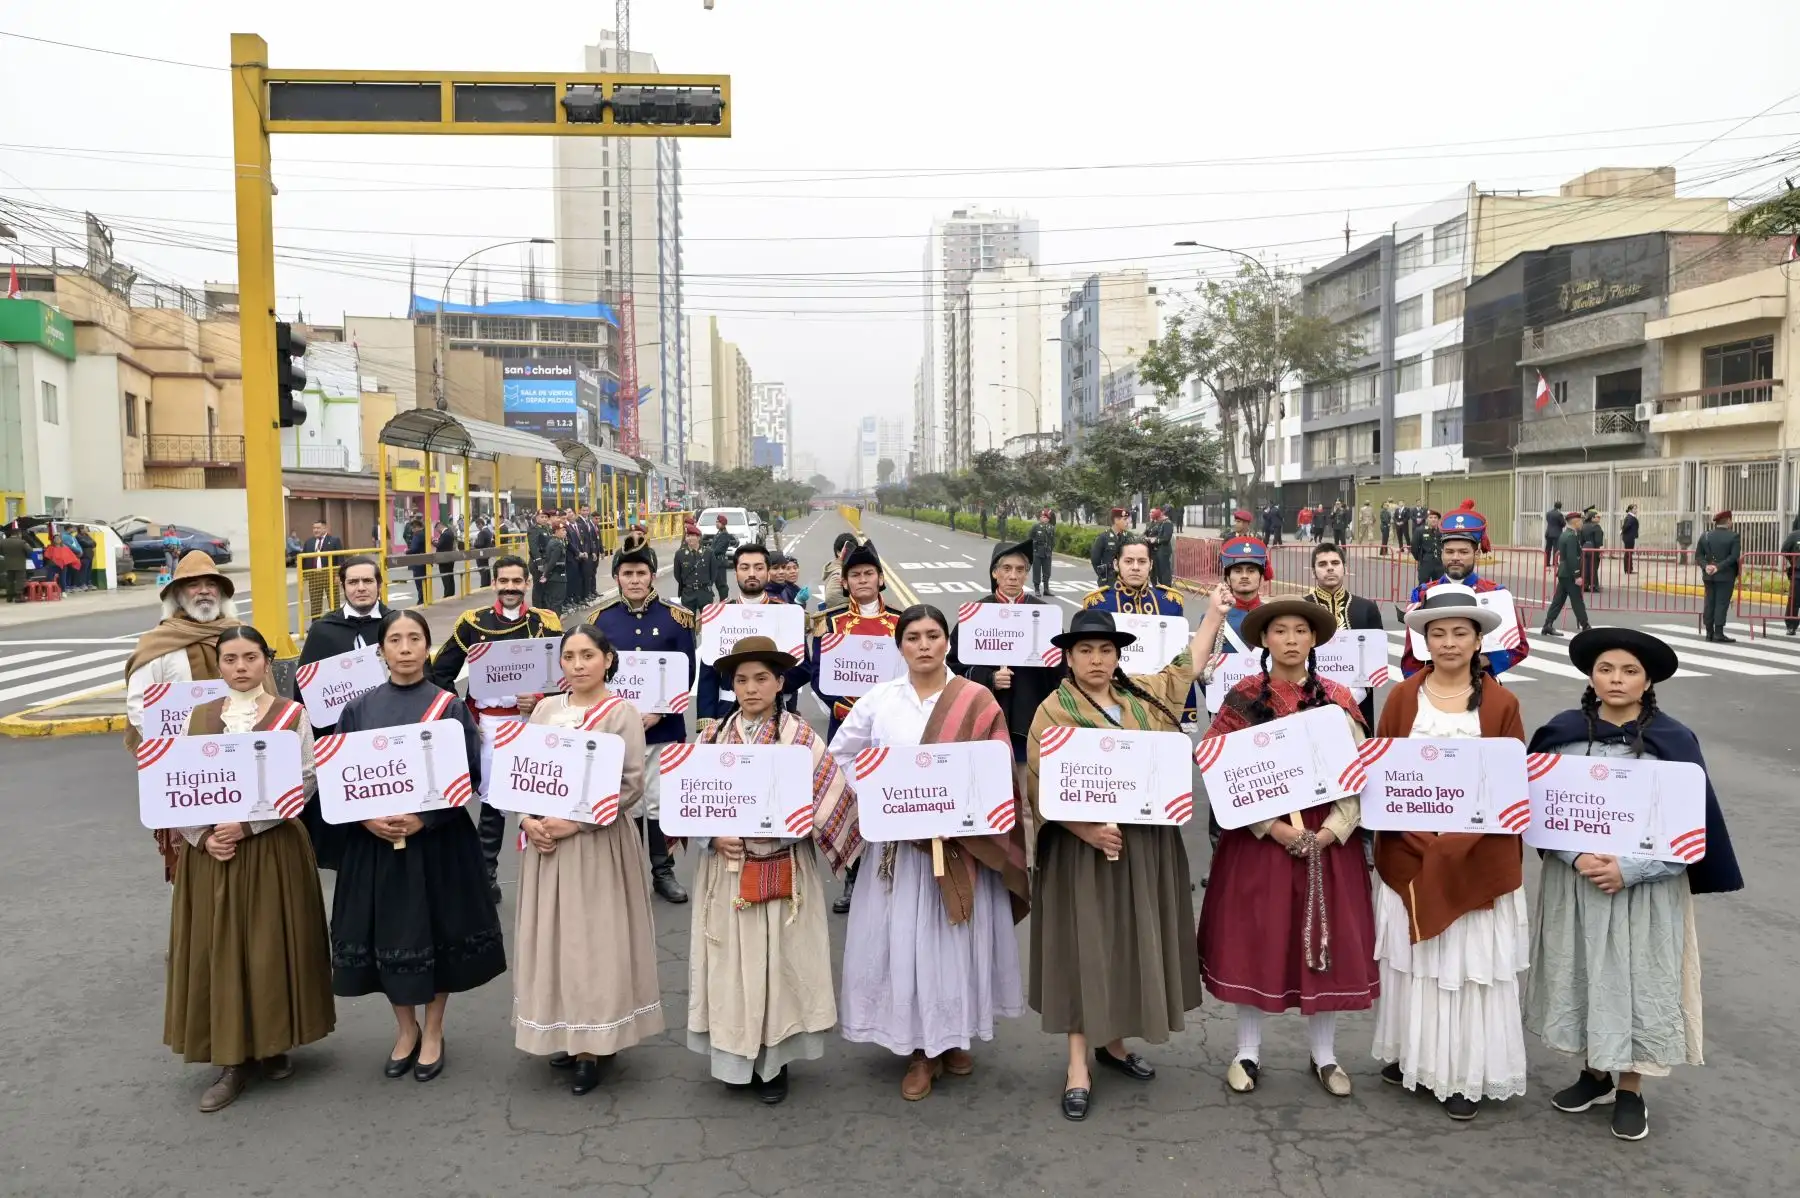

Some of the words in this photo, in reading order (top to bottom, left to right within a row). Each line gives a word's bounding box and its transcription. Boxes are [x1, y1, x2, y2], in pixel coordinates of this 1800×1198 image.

[504, 366, 524, 375] san
[532, 365, 572, 375] charbel
[901, 561, 974, 570] BUS
[720, 625, 758, 635] Antonio
[974, 628, 1025, 638] Guillermo
[974, 639, 1014, 651] Miller
[1123, 643, 1144, 653] aula
[486, 661, 535, 674] Domingo
[833, 657, 875, 670] Simón
[1314, 662, 1355, 672] ecochea
[486, 672, 522, 684] Nieto
[606, 674, 626, 685] osé
[629, 674, 645, 685] de
[833, 670, 879, 683] Bolívar
[321, 681, 353, 698] Alejo
[341, 758, 407, 783] Cleofé
[511, 755, 564, 778] María
[1060, 762, 1113, 776] Ejército
[1223, 760, 1276, 783] Ejército
[165, 768, 237, 789] Higinia
[1228, 782, 1246, 795] de
[1249, 765, 1304, 788] mujeres
[1384, 769, 1424, 782] María
[343, 778, 415, 802] Ramos
[510, 773, 570, 798] Toledo
[680, 778, 733, 794] Ejército
[1060, 776, 1077, 788] de
[1081, 778, 1137, 791] mujeres
[165, 787, 242, 808] Toledo
[680, 792, 698, 804] de
[701, 793, 757, 807] mujeres
[881, 785, 948, 801] Ventura
[1059, 789, 1081, 802] del
[1085, 790, 1117, 804] Perú
[1232, 792, 1255, 808] del
[1256, 782, 1290, 802] Perú
[1385, 785, 1433, 798] Parado
[1435, 786, 1465, 801] Jayo
[1545, 789, 1606, 806] Ejército
[680, 806, 702, 818] del
[705, 805, 738, 818] Perú
[882, 799, 956, 814] Ccalamaqui
[1385, 801, 1403, 813] de
[1406, 801, 1454, 814] Bellido
[1544, 803, 1564, 816] de
[1569, 806, 1635, 823] mujeres
[1544, 817, 1569, 830] del
[1573, 819, 1612, 835] Perú
